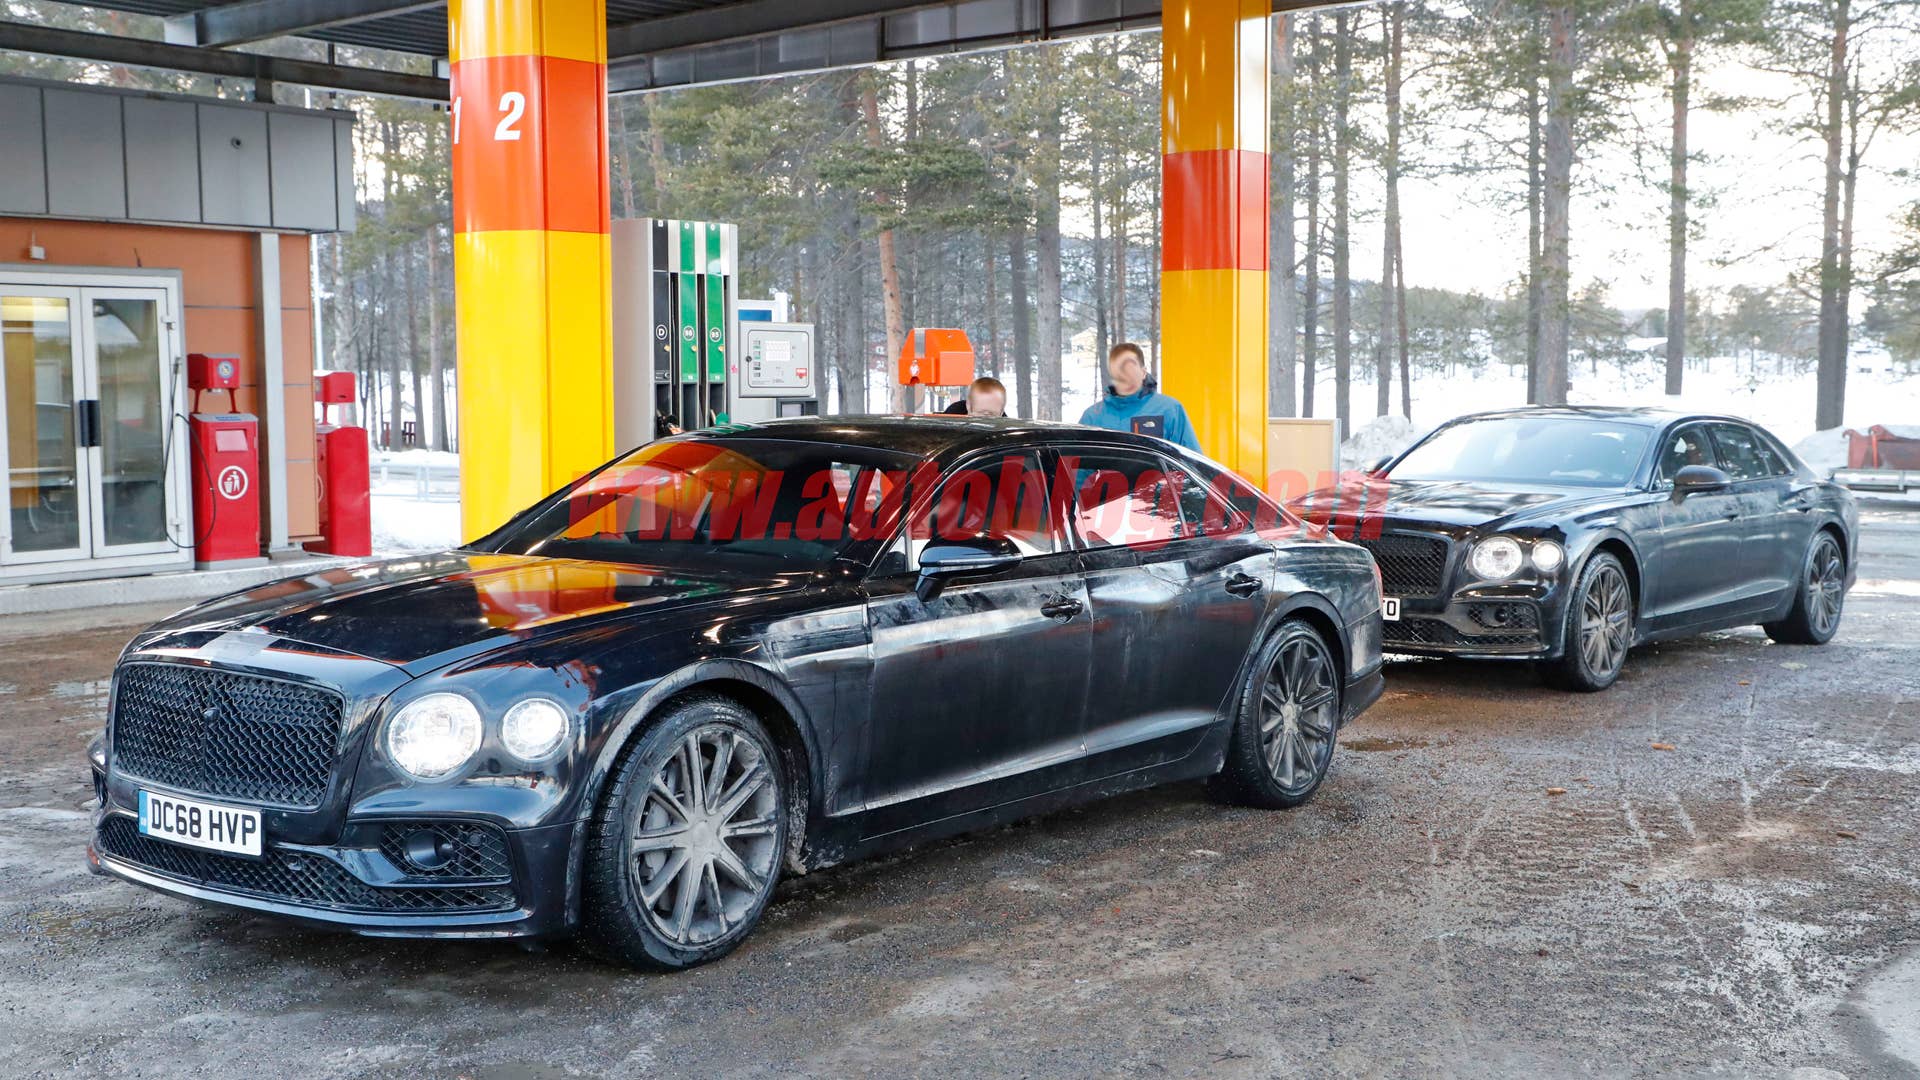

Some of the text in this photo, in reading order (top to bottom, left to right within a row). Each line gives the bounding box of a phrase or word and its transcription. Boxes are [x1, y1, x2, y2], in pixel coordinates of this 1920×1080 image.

[494, 91, 526, 141] 2
[151, 798, 257, 846] DC68 HVP
